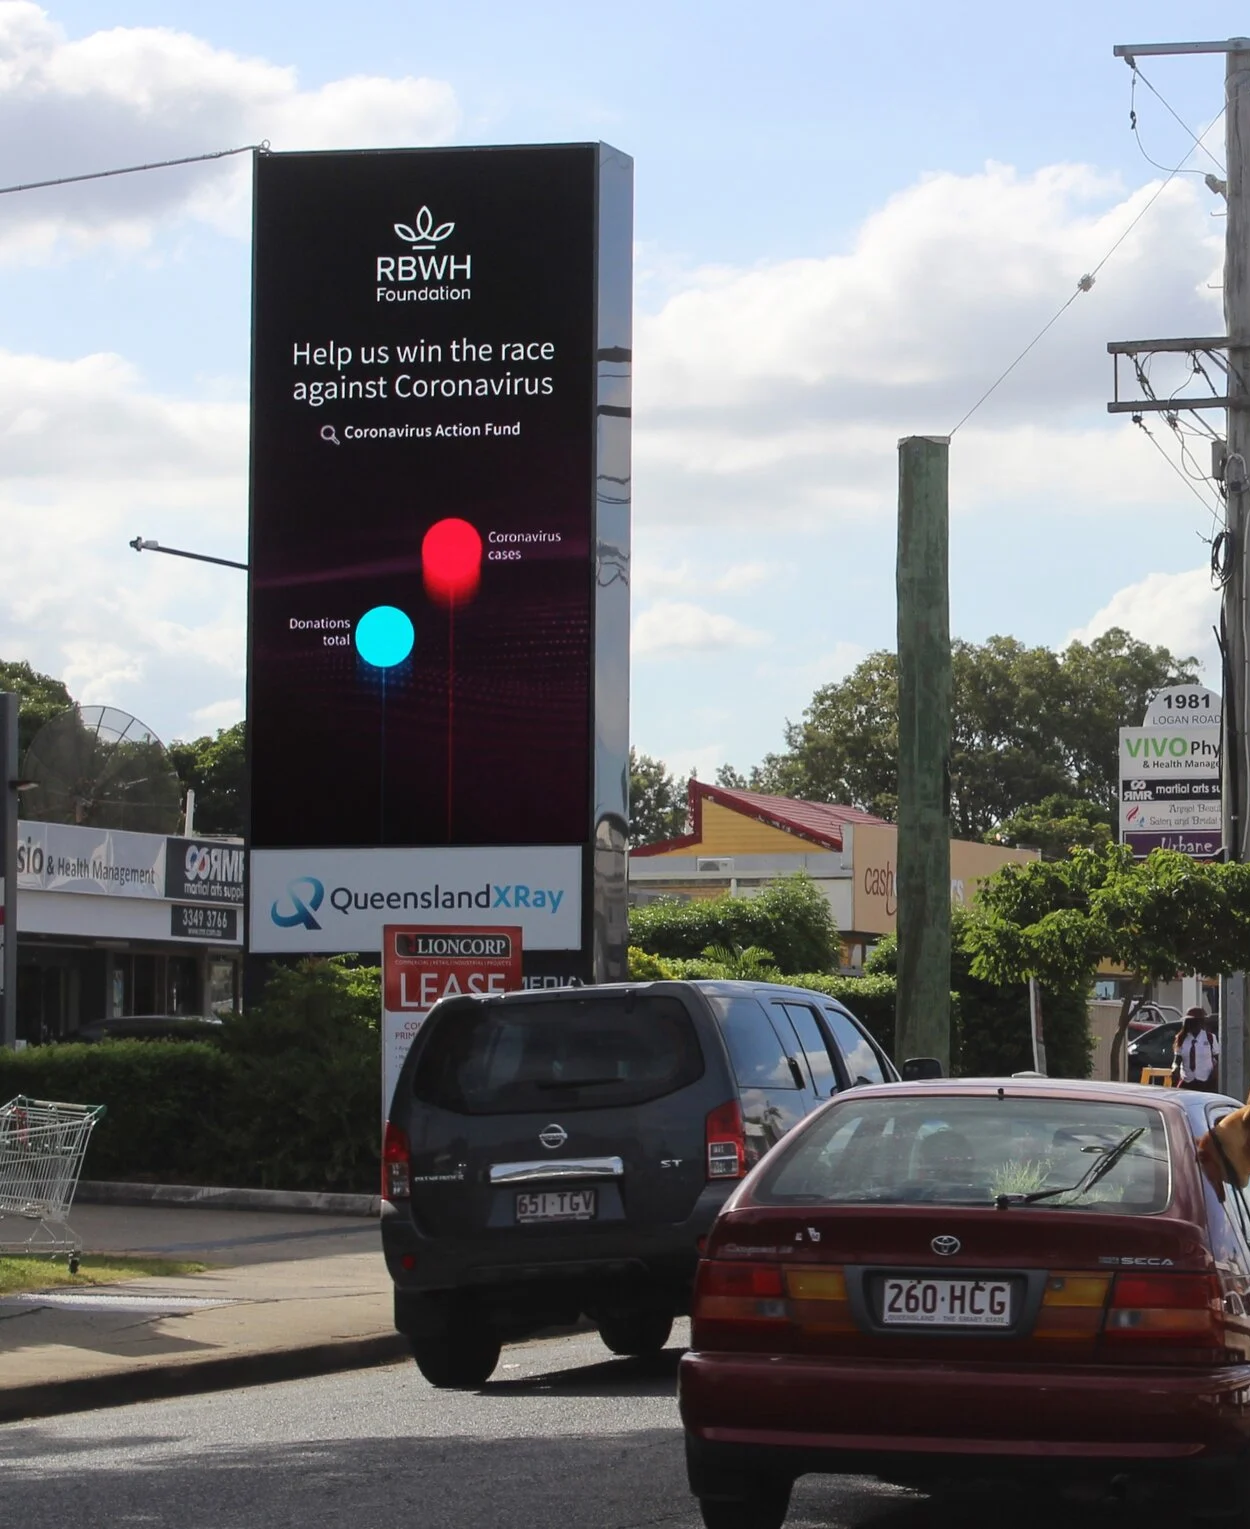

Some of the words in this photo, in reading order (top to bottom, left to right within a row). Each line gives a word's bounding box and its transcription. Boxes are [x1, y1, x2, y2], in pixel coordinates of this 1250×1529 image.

[376, 255, 472, 282] RBWH
[376, 286, 471, 302] Foundation
[293, 341, 353, 371] Help
[360, 344, 389, 364] us
[397, 339, 442, 363] win
[450, 337, 493, 361] the
[501, 342, 555, 361] race
[293, 375, 387, 407] against
[395, 372, 553, 398] Coronavirus
[344, 424, 432, 439] Coronavirus
[435, 423, 481, 437] Action
[485, 422, 521, 436] Fund
[488, 530, 562, 543] Coronavirus
[488, 548, 522, 561] cases
[289, 617, 351, 630] Donations
[323, 634, 350, 646] total
[1163, 694, 1210, 709] 1981
[1153, 716, 1189, 725] LOGAN
[1192, 714, 1221, 724] ROAD
[1125, 737, 1188, 758] VIVO
[1191, 740, 1221, 758] Phy
[1143, 761, 1150, 769] &
[1153, 760, 1182, 769] Health
[1156, 784, 1190, 794] martial
[1192, 784, 1209, 793] arts
[1161, 836, 1213, 852] Urbane
[47, 858, 54, 875] &
[58, 857, 90, 878] Health
[93, 860, 155, 886] Management
[184, 881, 209, 895] martial
[211, 883, 222, 896] arts
[183, 908, 203, 927] 3349
[207, 910, 228, 928] 3766
[417, 939, 506, 955] LIONCORP
[401, 972, 506, 1008] LEASE
[661, 1159, 683, 1168] ST
[1121, 1257, 1174, 1266] SECA
